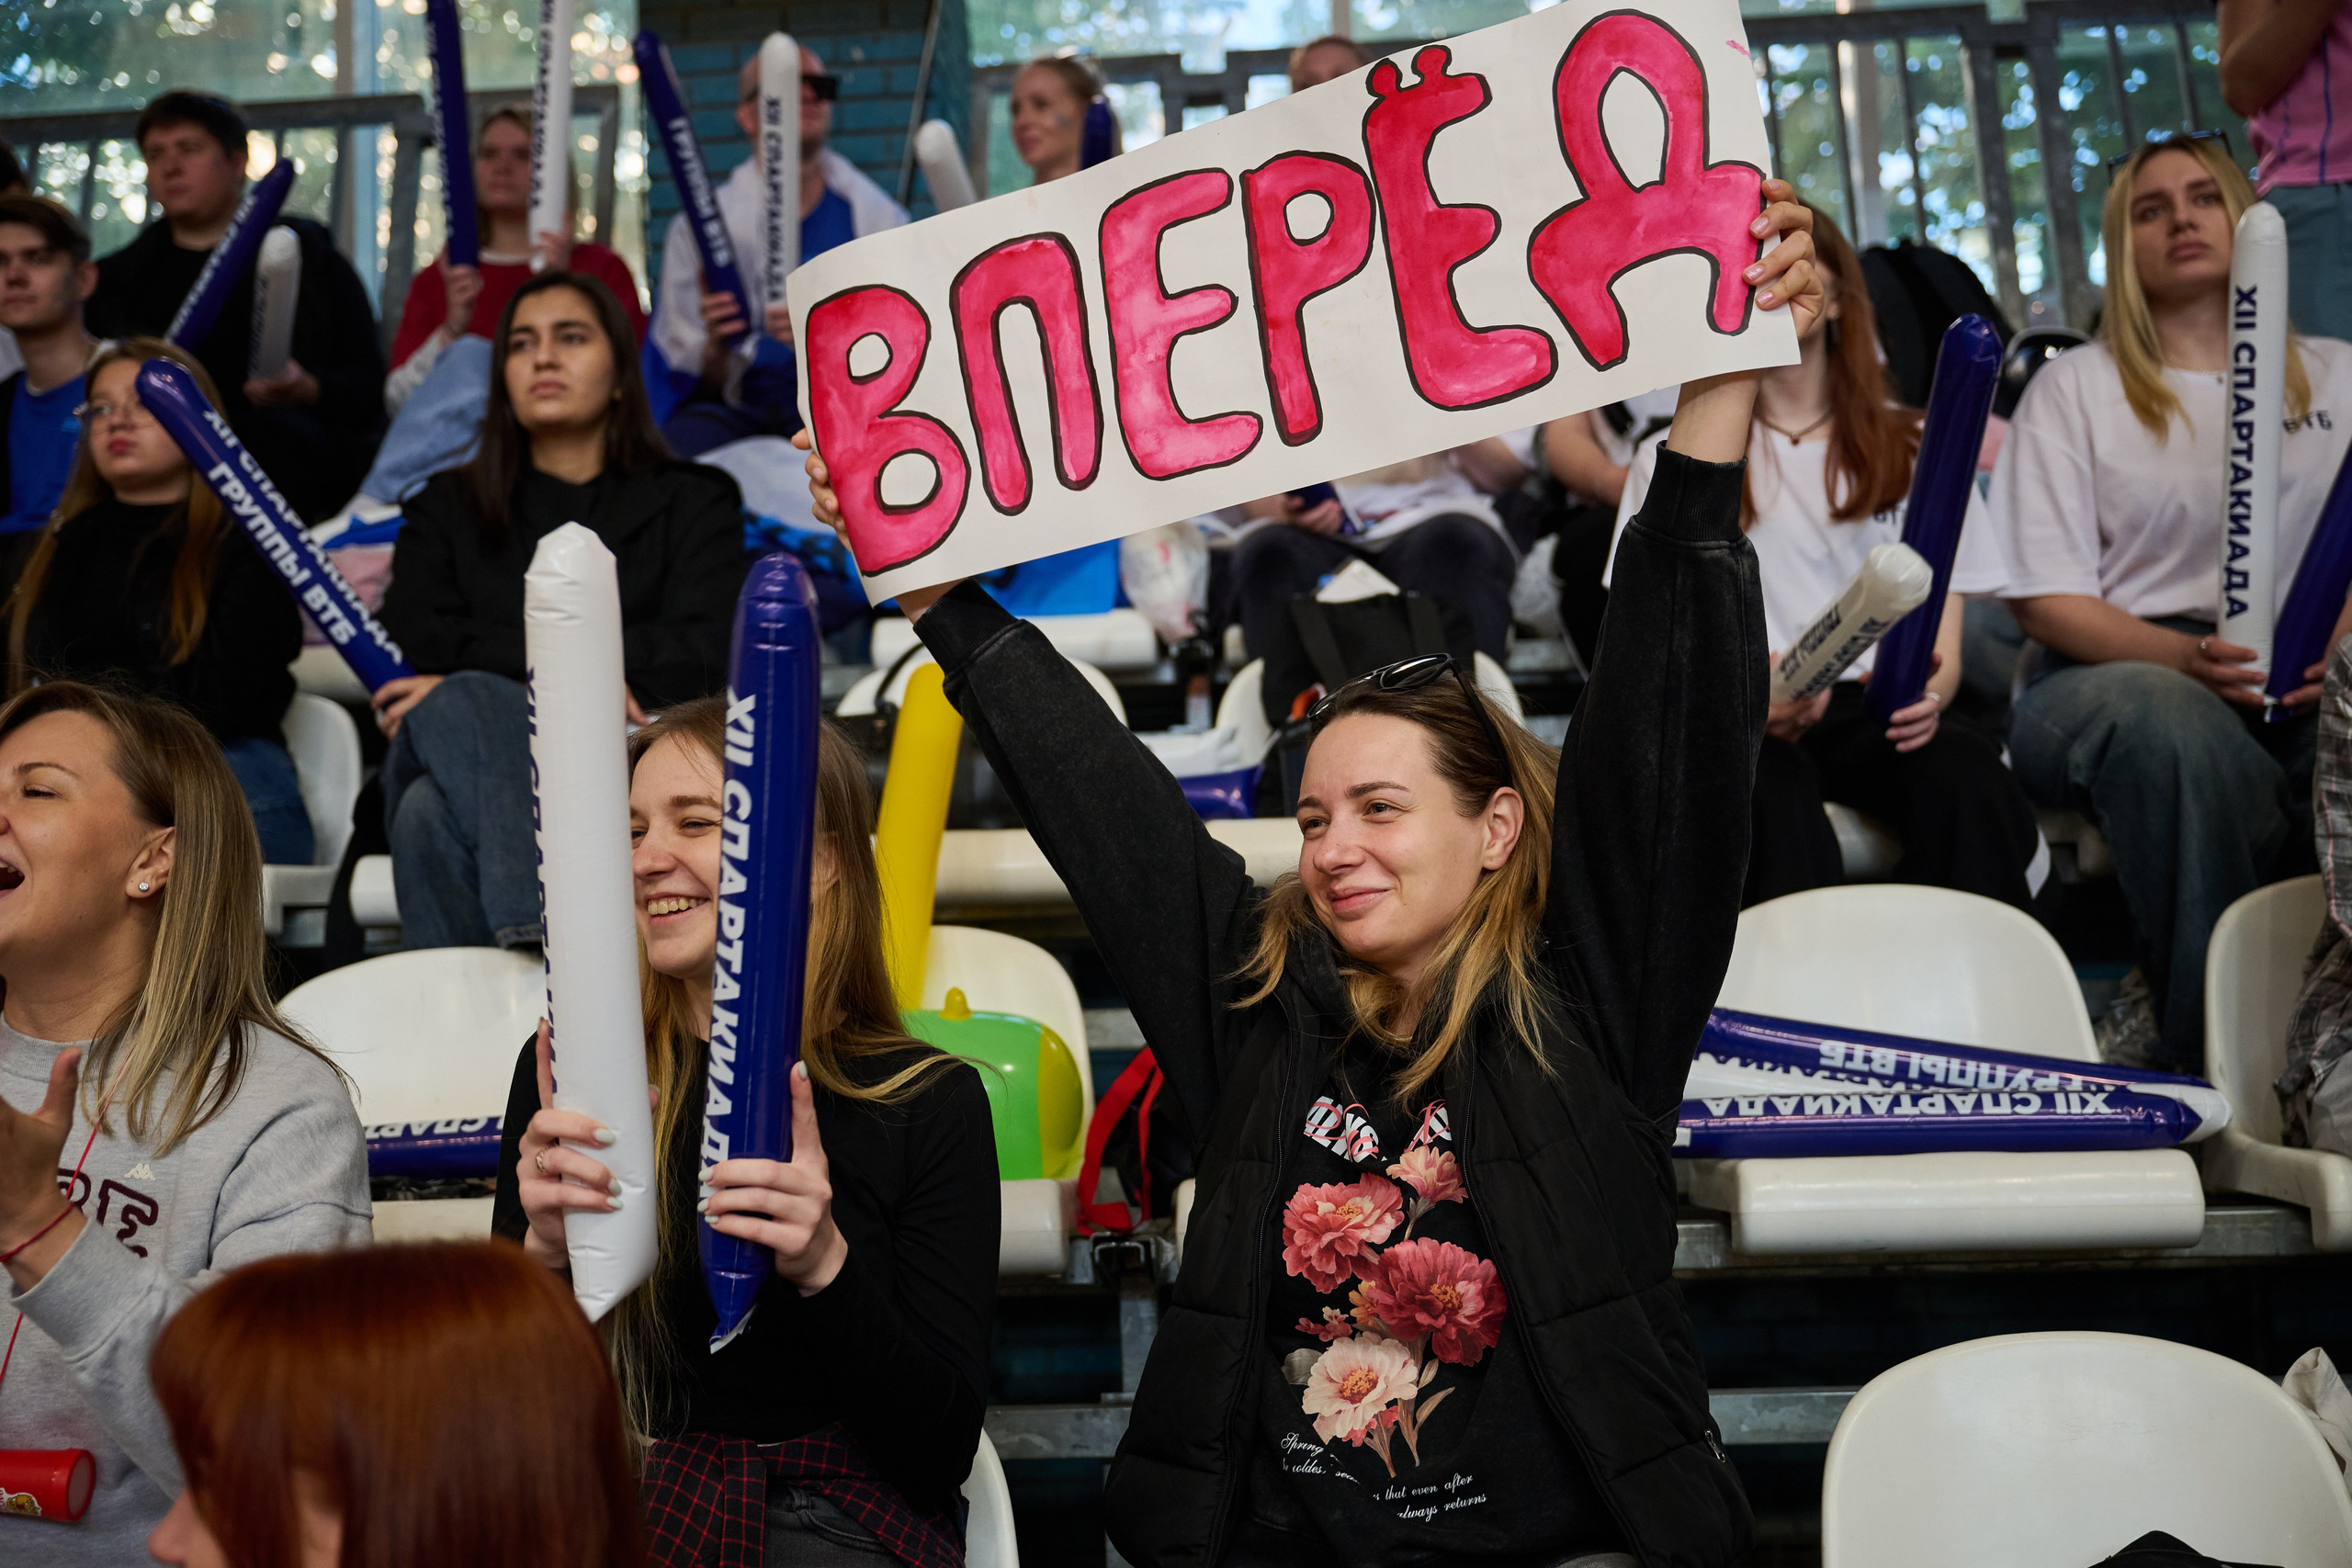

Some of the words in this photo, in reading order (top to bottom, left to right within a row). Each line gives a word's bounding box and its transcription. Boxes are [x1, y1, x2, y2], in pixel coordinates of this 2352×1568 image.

[806, 8, 1767, 577] ВПЕРЁД
[2234, 284, 2257, 331] XII
[2225, 340, 2257, 621] СПАРТАКИАДА
[208, 461, 312, 587] ГРУППЫ
[302, 583, 358, 645] ВТБ
[723, 691, 756, 767] XII
[1818, 1039, 1898, 1077] ВТБ
[1702, 1091, 2042, 1118] СПАРТАКИАДА
[2055, 1091, 2113, 1115] XII
[1281, 1432, 1325, 1457] Spring
[1385, 1484, 1408, 1501] that
[1411, 1485, 1439, 1496] even
[1444, 1472, 1474, 1494] after
[1443, 1493, 1487, 1512] returns
